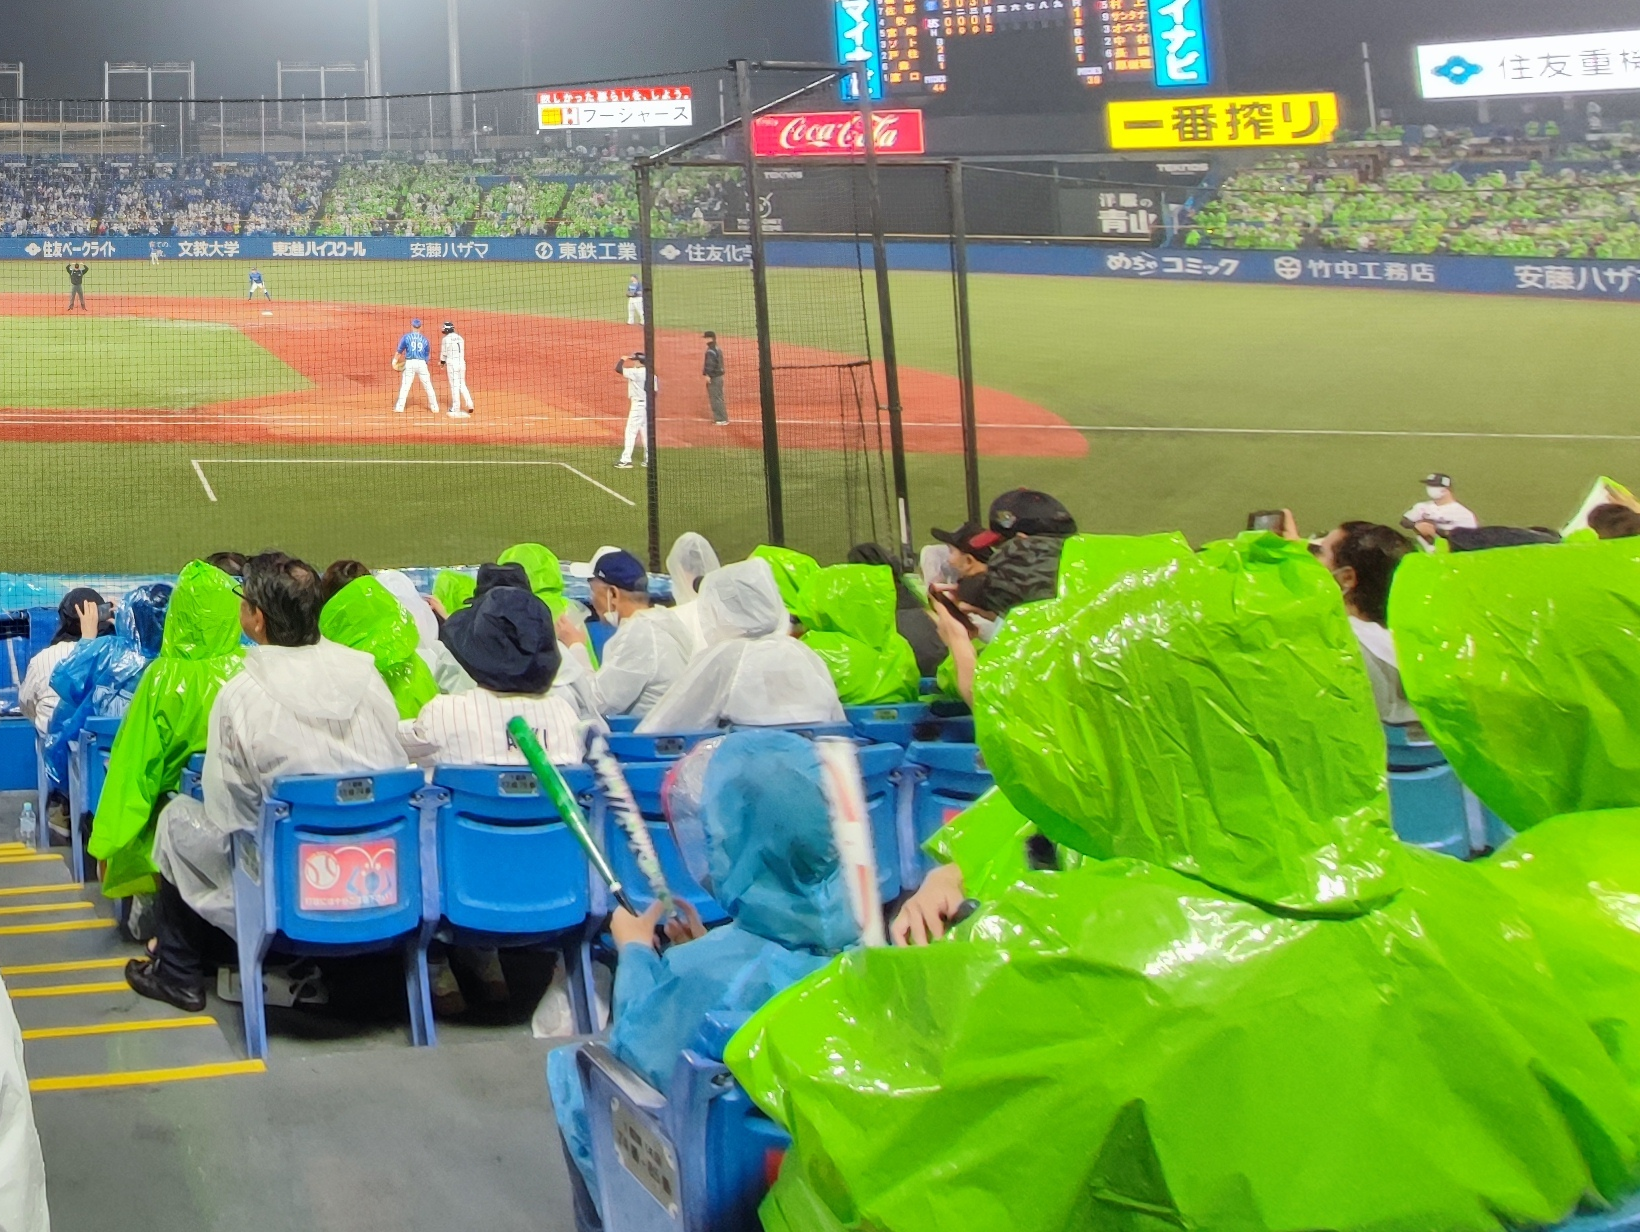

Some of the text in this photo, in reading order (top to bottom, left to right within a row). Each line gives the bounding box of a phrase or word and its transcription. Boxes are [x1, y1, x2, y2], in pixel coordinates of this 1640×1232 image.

[583, 106, 689, 124] フーシャース
[1123, 101, 1321, 142] 一番搾り
[1097, 208, 1158, 234] 青山
[42, 240, 116, 258] 住友ベークライト
[177, 240, 240, 258] 文教大学
[272, 241, 367, 257] 東進ハイスクール
[410, 242, 489, 259] 安藤ハザマ
[558, 242, 638, 261] 東鉄工業
[1106, 252, 1240, 276] めちゃコミック
[1307, 258, 1436, 283] 竹中工務店
[1513, 264, 1640, 293] 安藤ハザ
[410, 341, 424, 352] 99
[505, 727, 548, 751] AI
